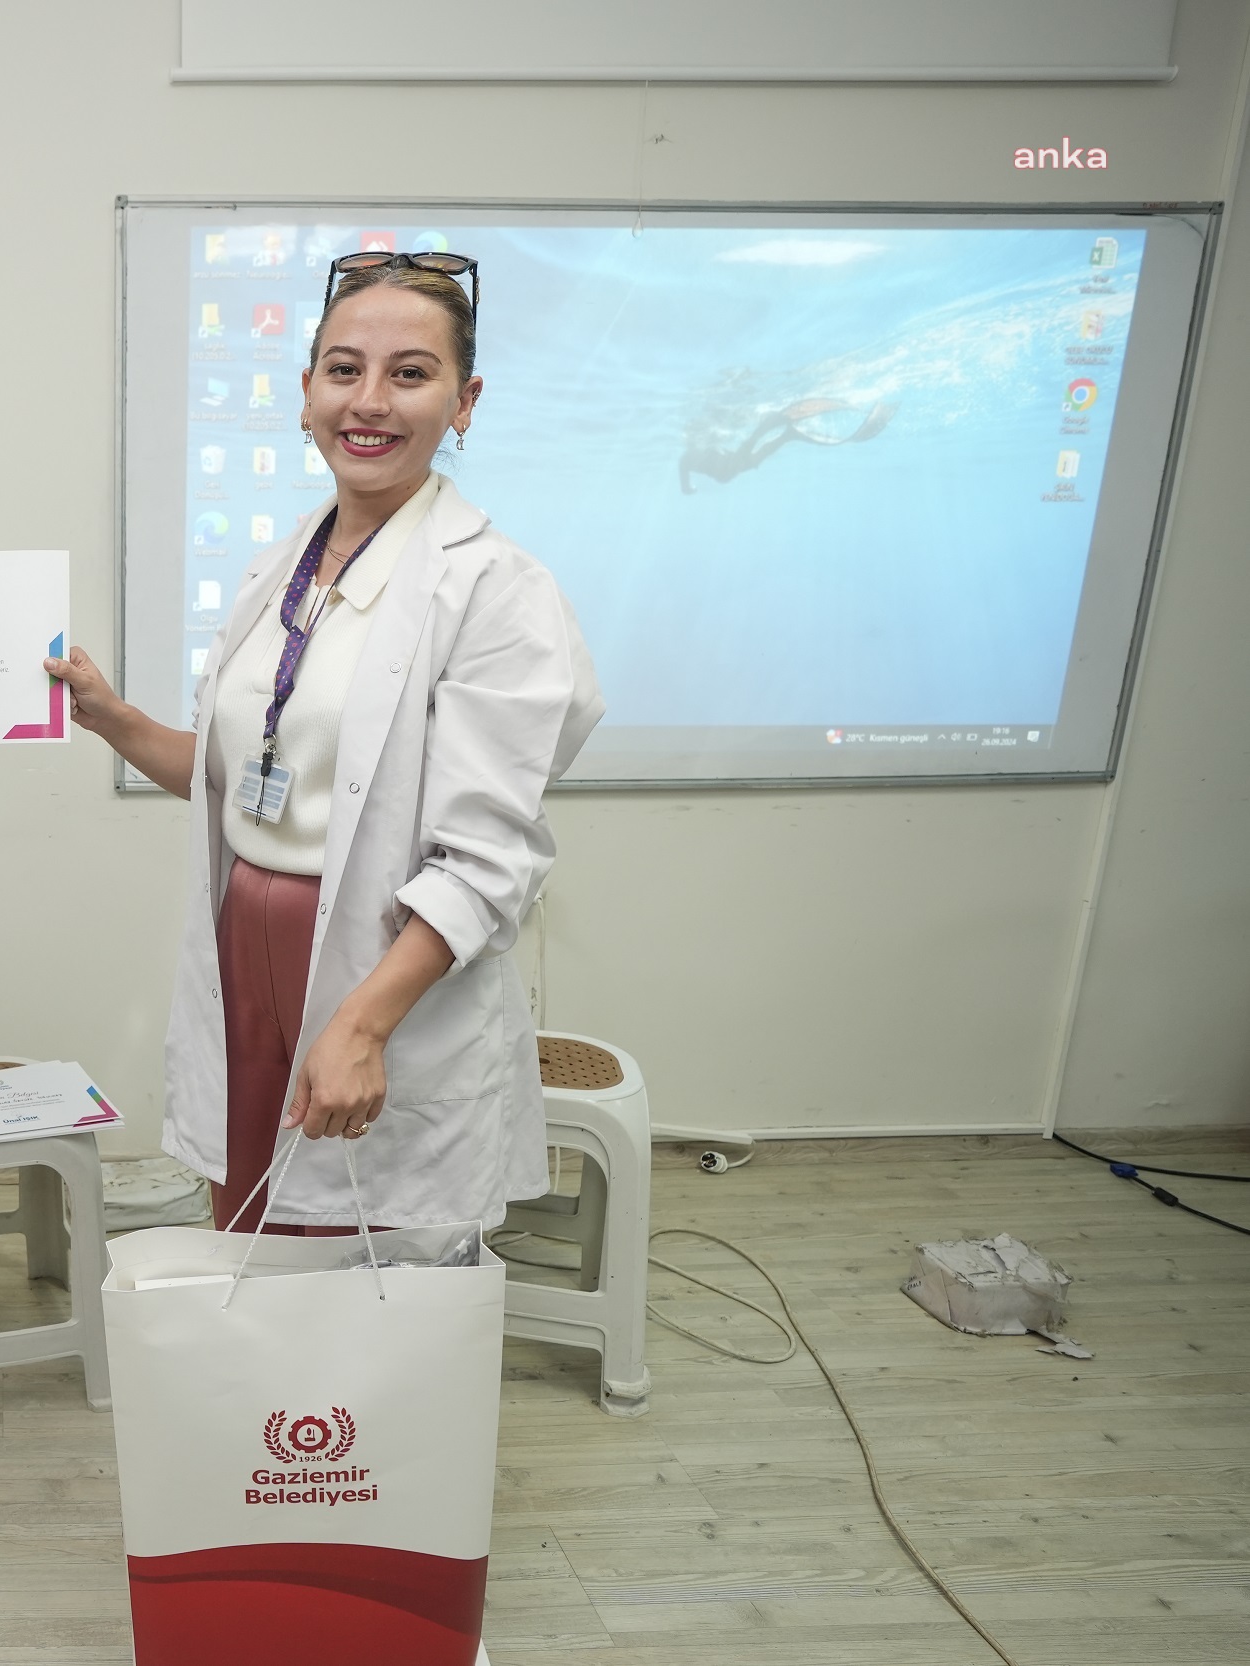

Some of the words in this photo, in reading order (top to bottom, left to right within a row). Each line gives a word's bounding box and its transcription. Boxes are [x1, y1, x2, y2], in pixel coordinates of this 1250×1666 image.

[299, 1455, 323, 1463] 1926
[251, 1465, 370, 1485] Gaziemir
[245, 1484, 378, 1507] Belediyesi
